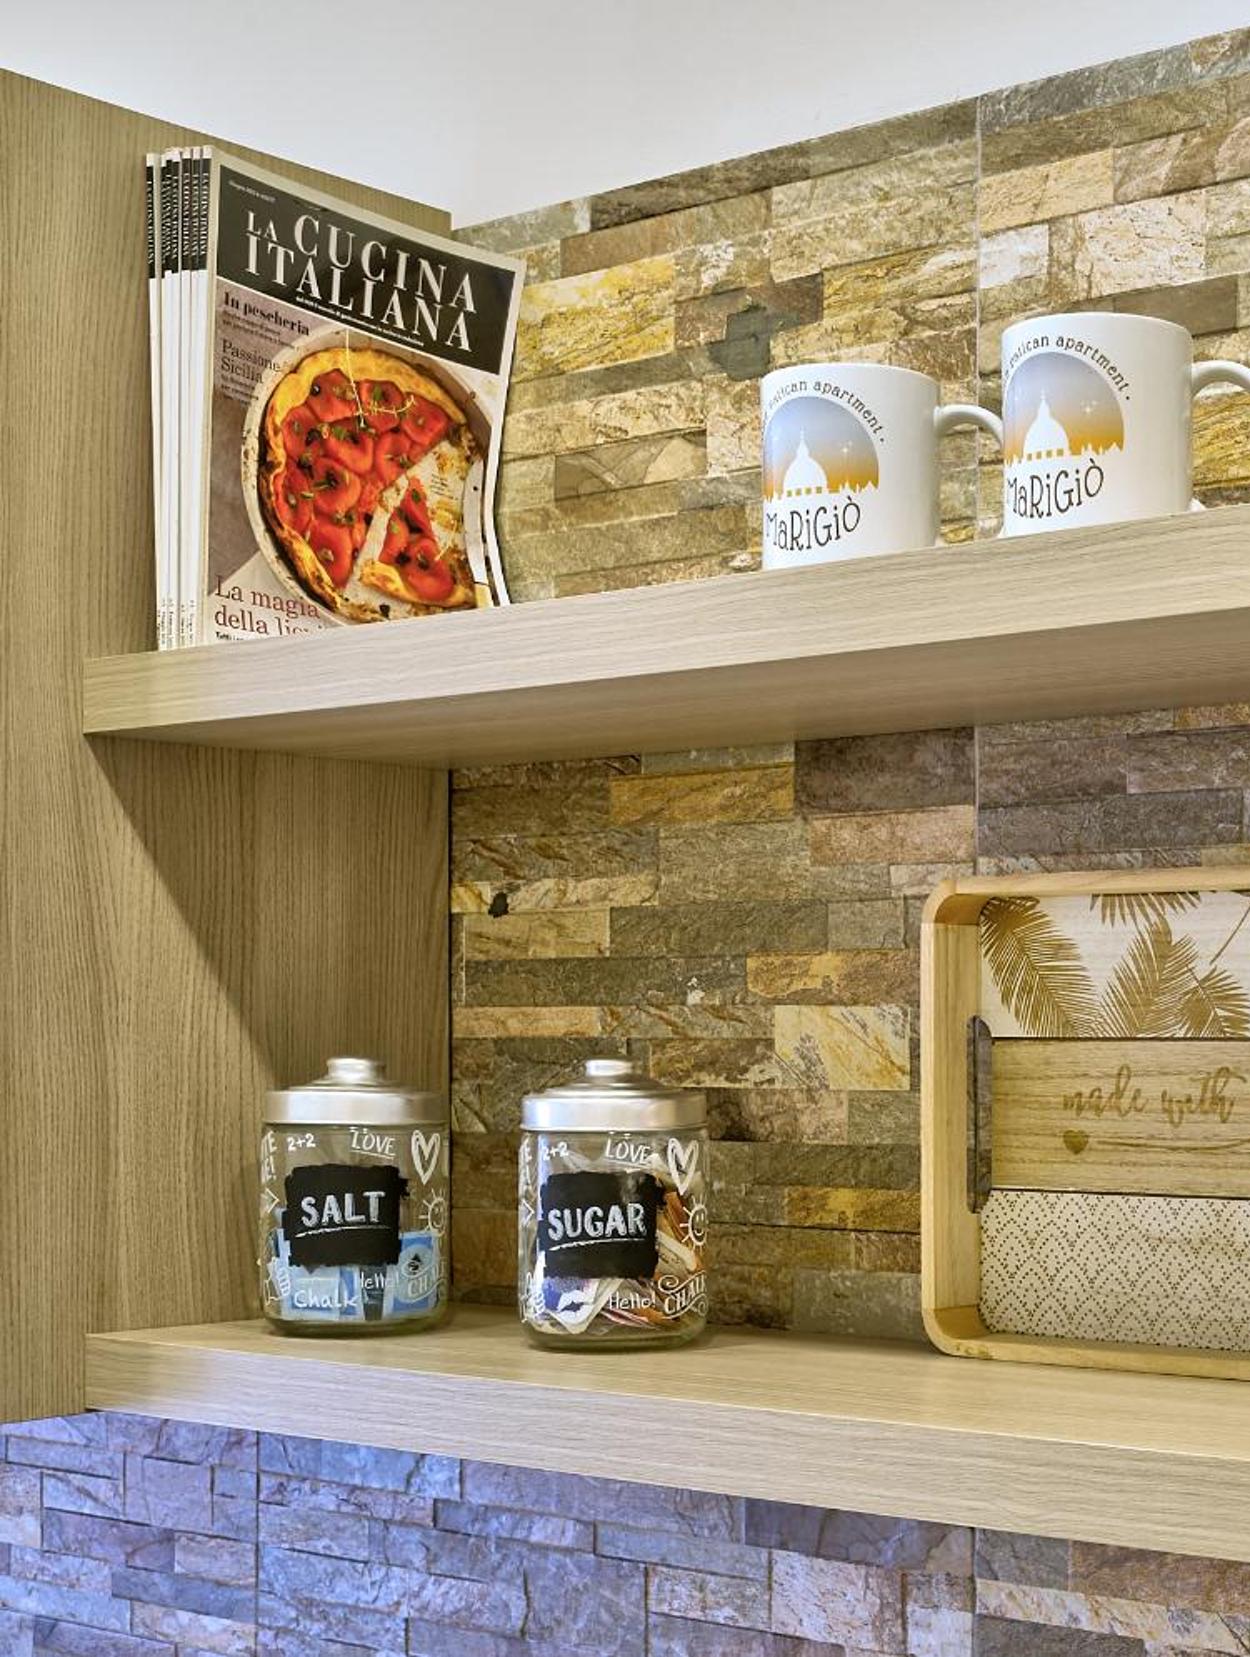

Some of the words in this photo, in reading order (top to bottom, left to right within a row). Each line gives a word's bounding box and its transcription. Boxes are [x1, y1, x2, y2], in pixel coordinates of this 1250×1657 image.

[247, 210, 278, 242] LA
[294, 214, 477, 314] CUCINA
[244, 232, 472, 352] ITALIANA
[224, 292, 239, 309] In
[244, 303, 309, 336] pescheria
[221, 356, 264, 384] Sicilia
[222, 339, 282, 373] Passione
[215, 575, 244, 602] La
[251, 590, 321, 619] magia
[214, 605, 270, 636] della
[1062, 1063, 1148, 1118] made
[1161, 1066, 1248, 1127] with
[287, 1133, 316, 1151] 2+2
[351, 1128, 396, 1155] LOVE
[606, 1138, 651, 1163] LOVE
[300, 1191, 386, 1227] SALT
[547, 1203, 647, 1242] SUGAR
[608, 1290, 656, 1310] Hello!
